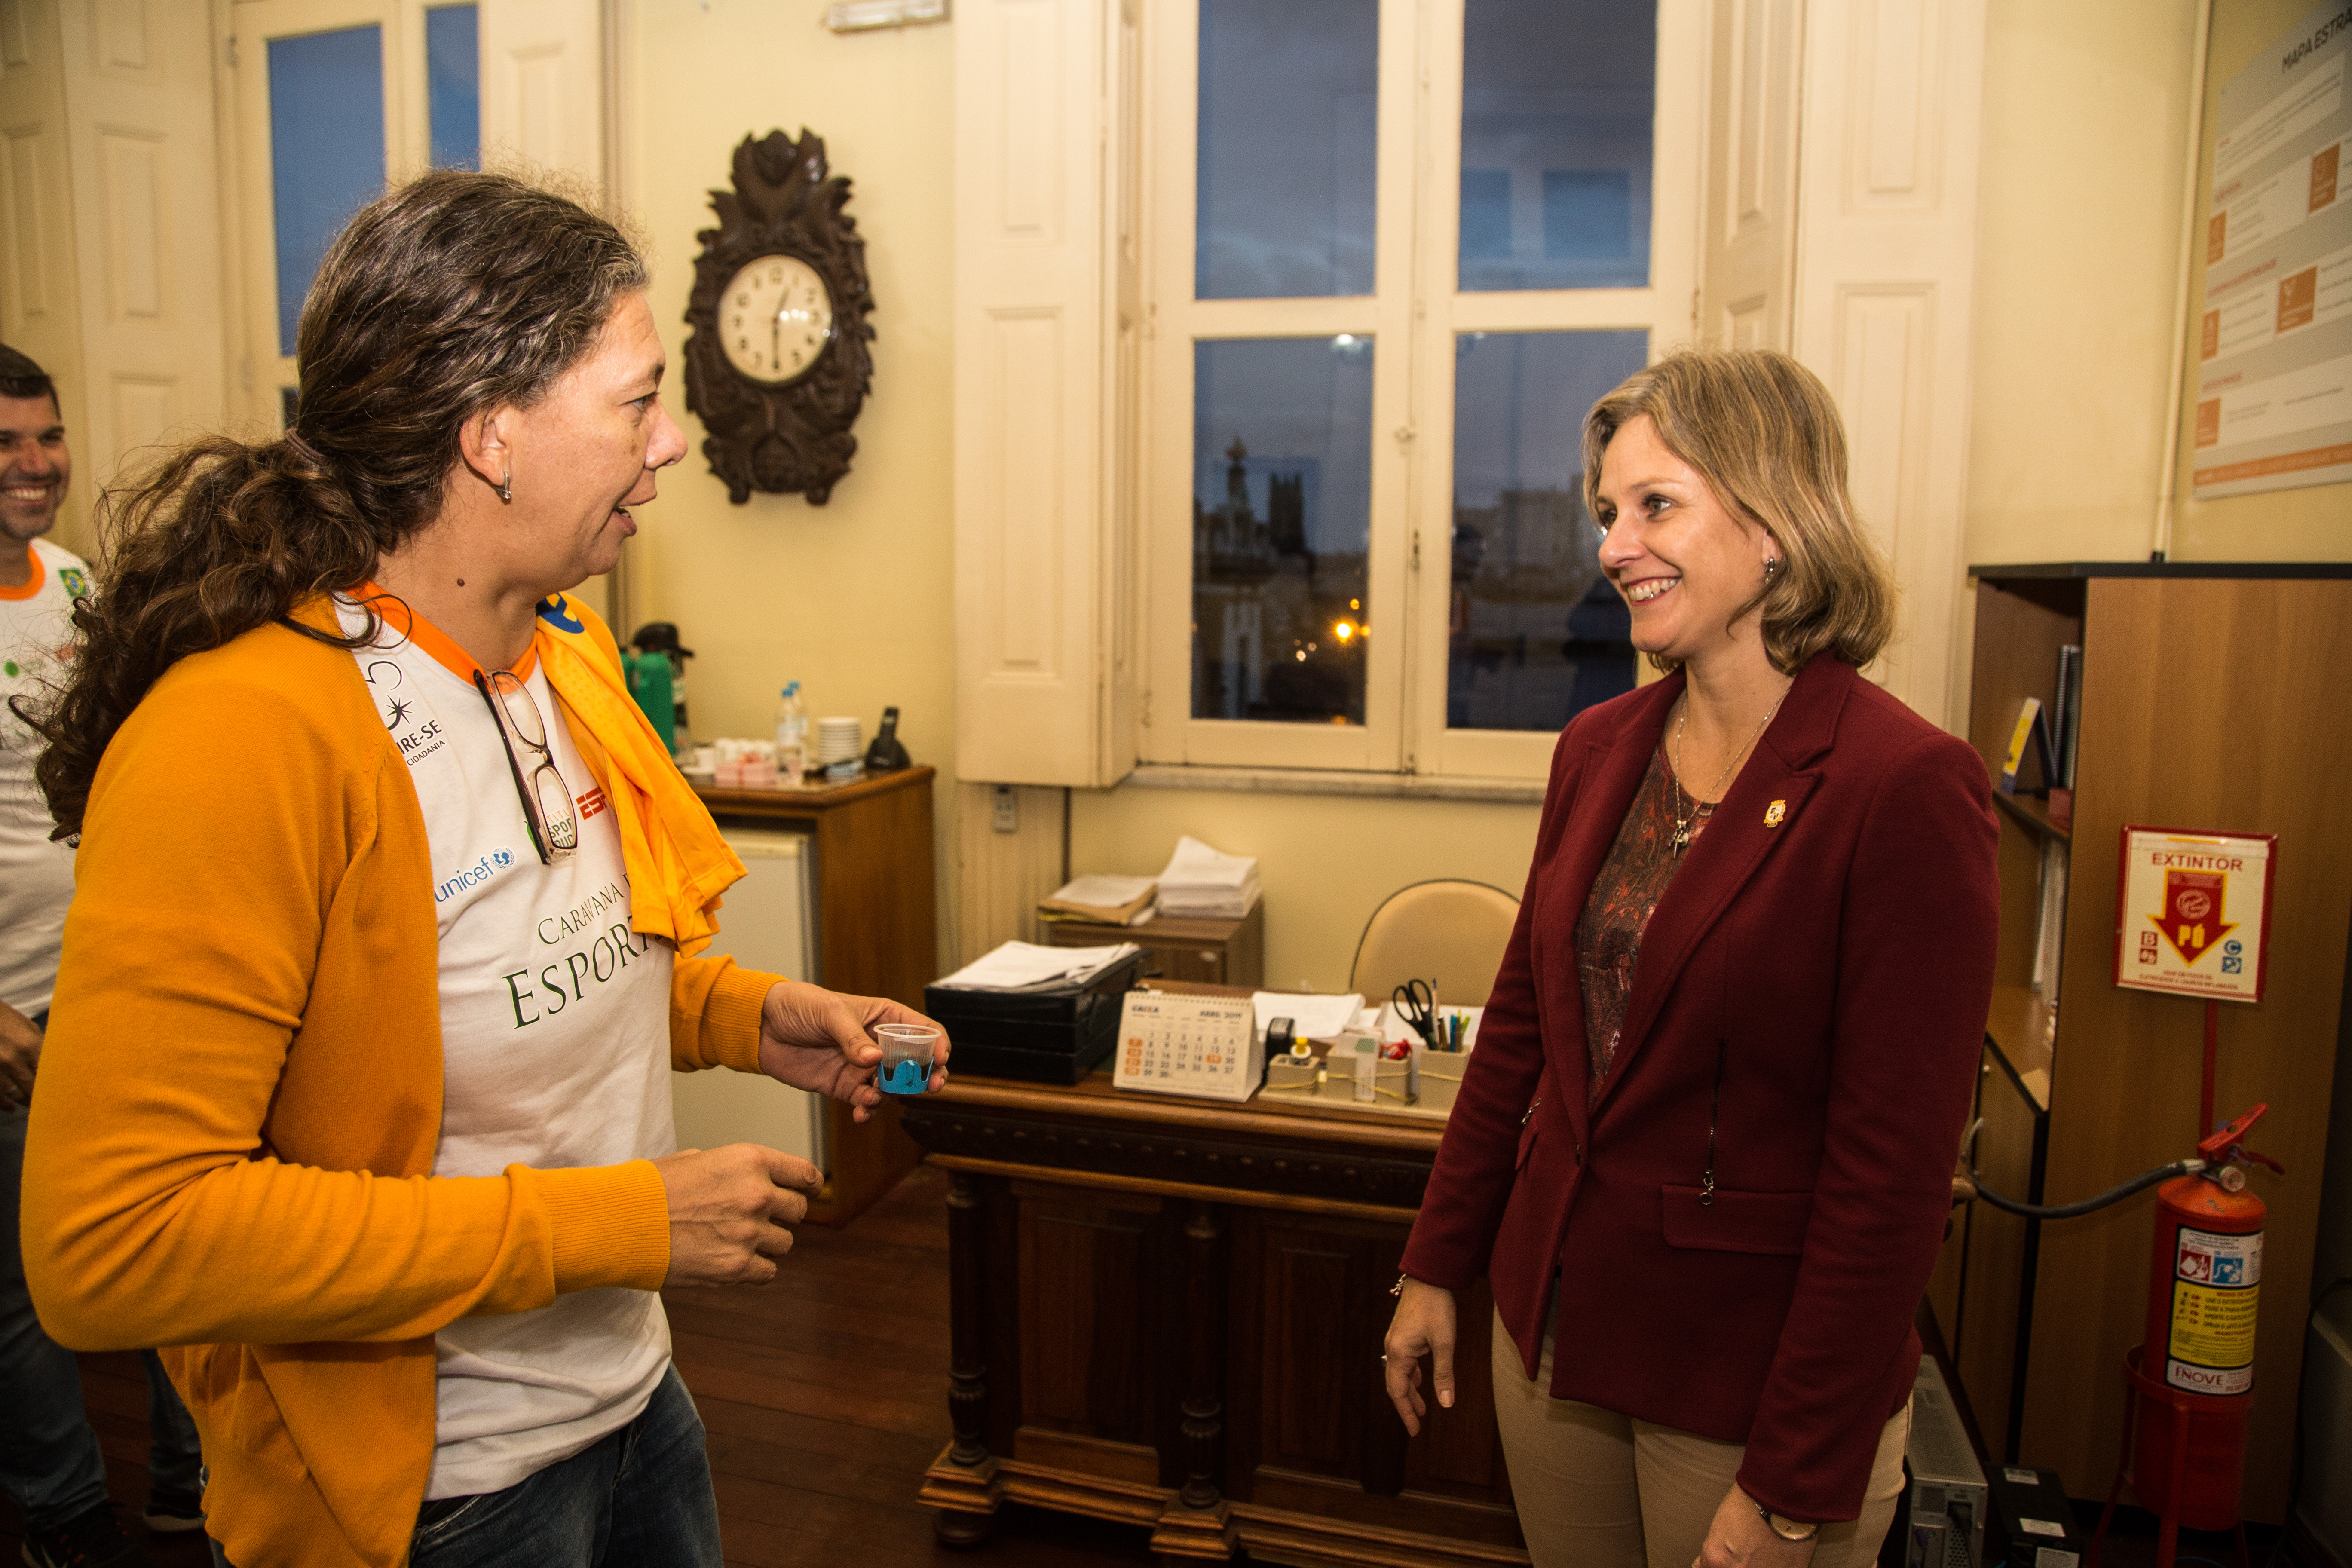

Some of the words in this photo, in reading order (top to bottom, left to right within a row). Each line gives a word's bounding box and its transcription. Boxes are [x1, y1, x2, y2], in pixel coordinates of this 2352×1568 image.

[2281, 37, 2313, 74] MAPA
[407, 740, 446, 766] CIDADANIA
[575, 786, 607, 820] ES
[2152, 852, 2242, 872] EXTINTOR
[434, 857, 494, 902] unicef
[538, 882, 625, 945] CARAVANA
[2178, 923, 2205, 948] PÓ
[2175, 1365, 2223, 1386] INOVE
